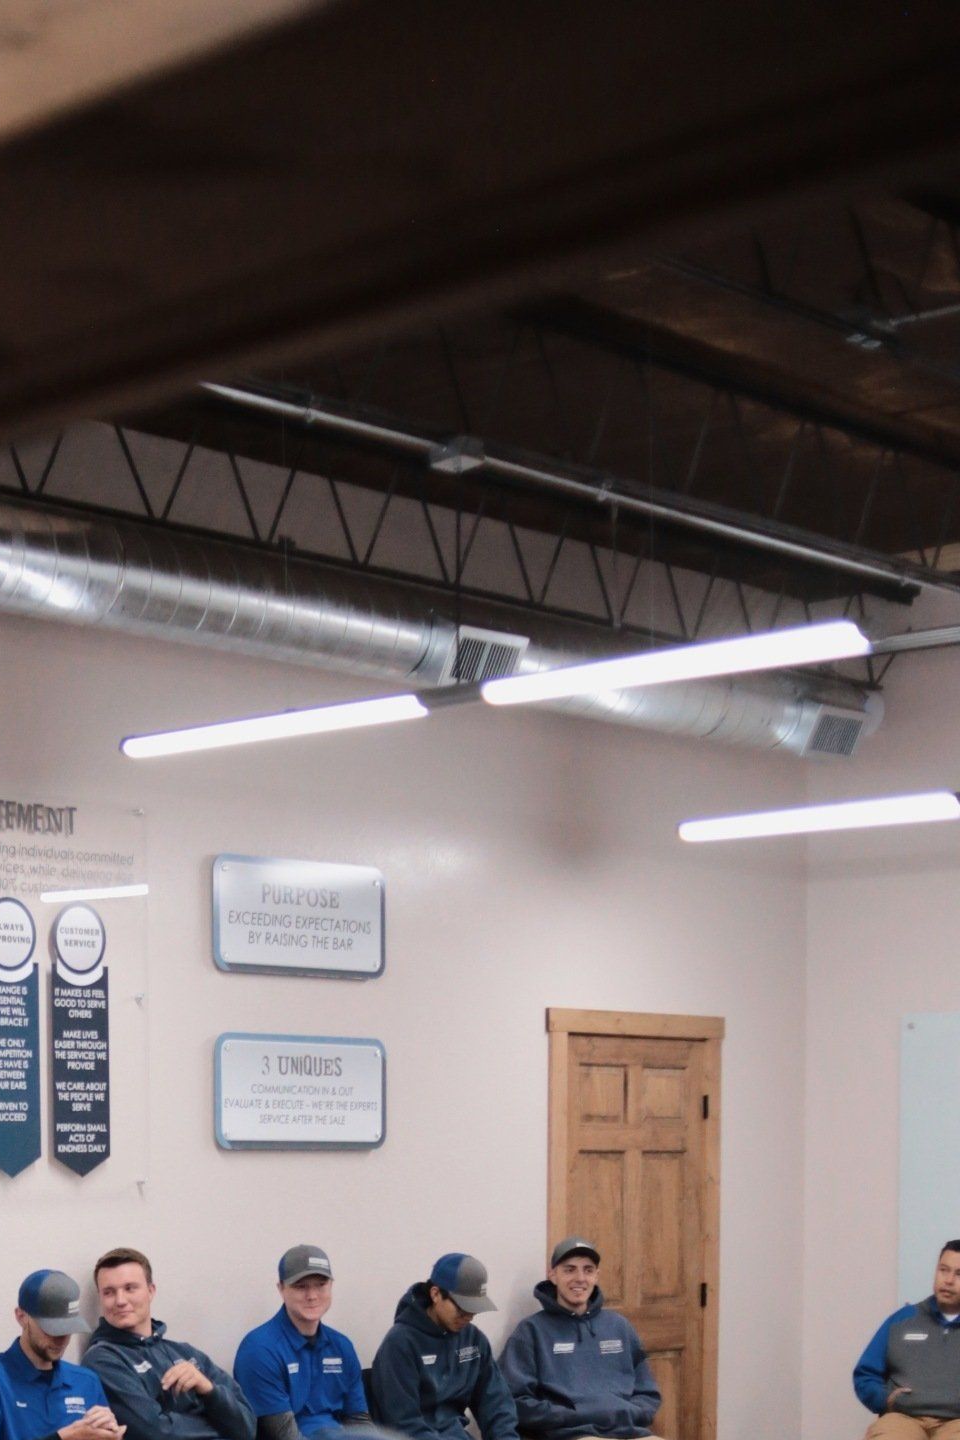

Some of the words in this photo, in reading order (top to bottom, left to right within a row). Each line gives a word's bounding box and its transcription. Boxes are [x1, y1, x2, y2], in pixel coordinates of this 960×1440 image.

[261, 883, 340, 909] PURPOSE
[228, 910, 292, 928] EXCEEDING
[295, 916, 371, 935] EXPECTATIONS
[60, 926, 99, 936] CUSTOMER
[64, 940, 96, 948] SERVICE
[248, 931, 261, 944] BY
[265, 932, 308, 948] RAISING
[311, 936, 329, 949] THE
[332, 937, 353, 951] BAR
[61, 988, 82, 997] MAKES
[83, 989, 91, 997] US
[92, 989, 105, 998] FEEL
[54, 999, 76, 1008] GOOD
[77, 999, 86, 1008] TO
[87, 1000, 106, 1009] SERVE
[68, 1009, 92, 1018] OTHERS
[63, 1030, 81, 1039] MAKE
[82, 1030, 98, 1039] LIVES
[7, 1039, 25, 1048] ONLY
[55, 1050, 66, 1059] THE
[67, 1051, 95, 1060] SERVICES
[96, 1052, 107, 1060] WE
[4, 1060, 22, 1069] HAVE
[67, 1061, 95, 1070] PROVIDE
[261, 1055, 270, 1075] 3
[278, 1055, 342, 1077] UNIQUES
[10, 1081, 27, 1090] EARS
[55, 1082, 66, 1090] WE
[67, 1082, 85, 1091] CARE
[86, 1082, 107, 1091] ABOUT
[58, 1092, 69, 1101] THE
[70, 1092, 93, 1101] PEOPLE
[94, 1093, 104, 1101] WE
[19, 1102, 29, 1111] TO
[72, 1103, 91, 1111] SERVE
[56, 1123, 86, 1132] PERFORM
[87, 1123, 107, 1132] SMALL
[69, 1134, 85, 1142] ACTS
[86, 1134, 95, 1142] OF
[58, 1144, 87, 1152] KINDNESS
[88, 1144, 106, 1152] DAILY
